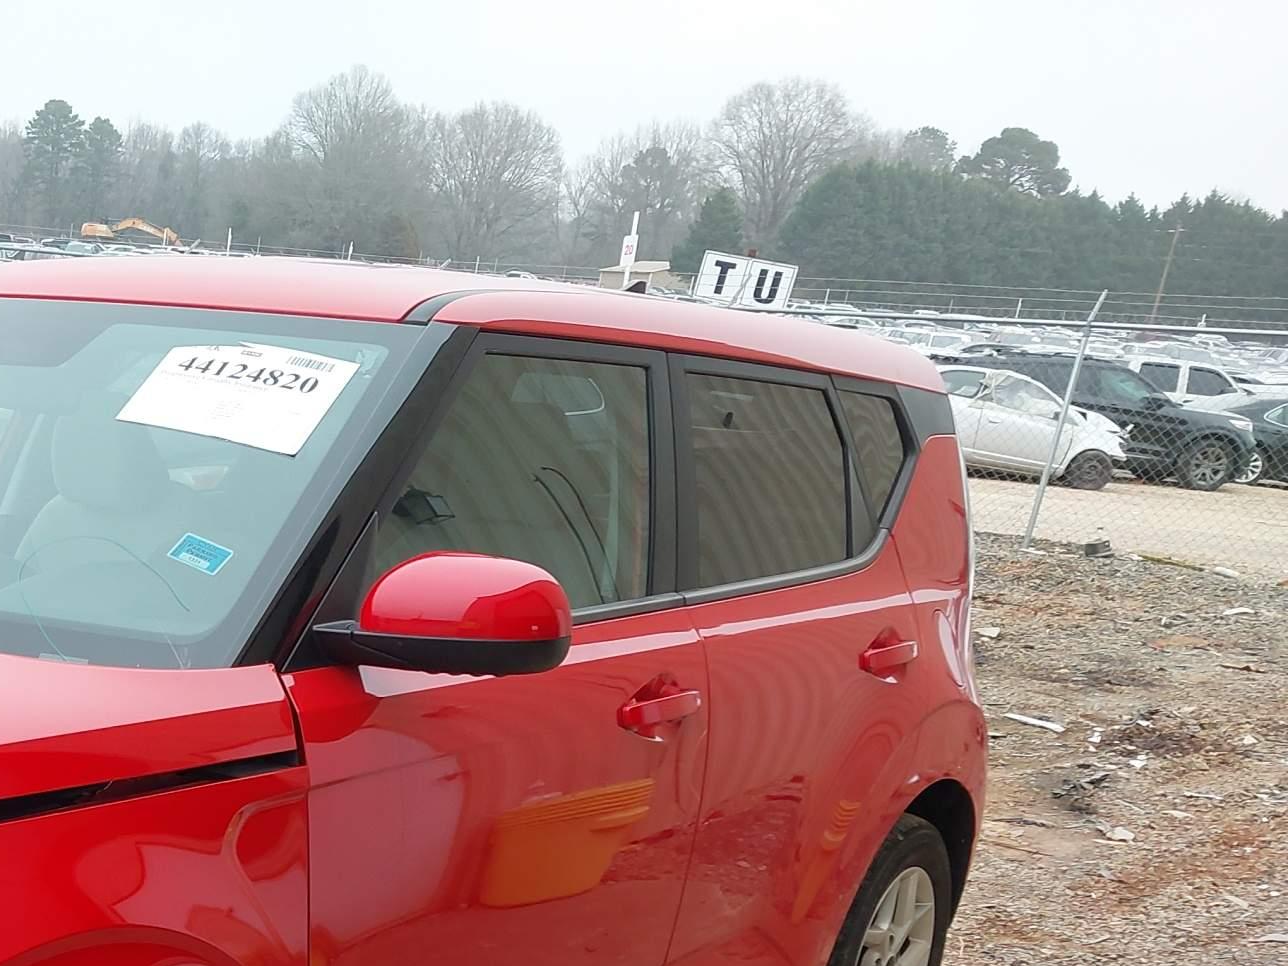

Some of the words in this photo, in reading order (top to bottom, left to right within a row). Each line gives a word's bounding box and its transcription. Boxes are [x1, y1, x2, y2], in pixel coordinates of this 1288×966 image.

[713, 260, 737, 295] T
[753, 268, 784, 305] U
[177, 356, 320, 394] 44124820
